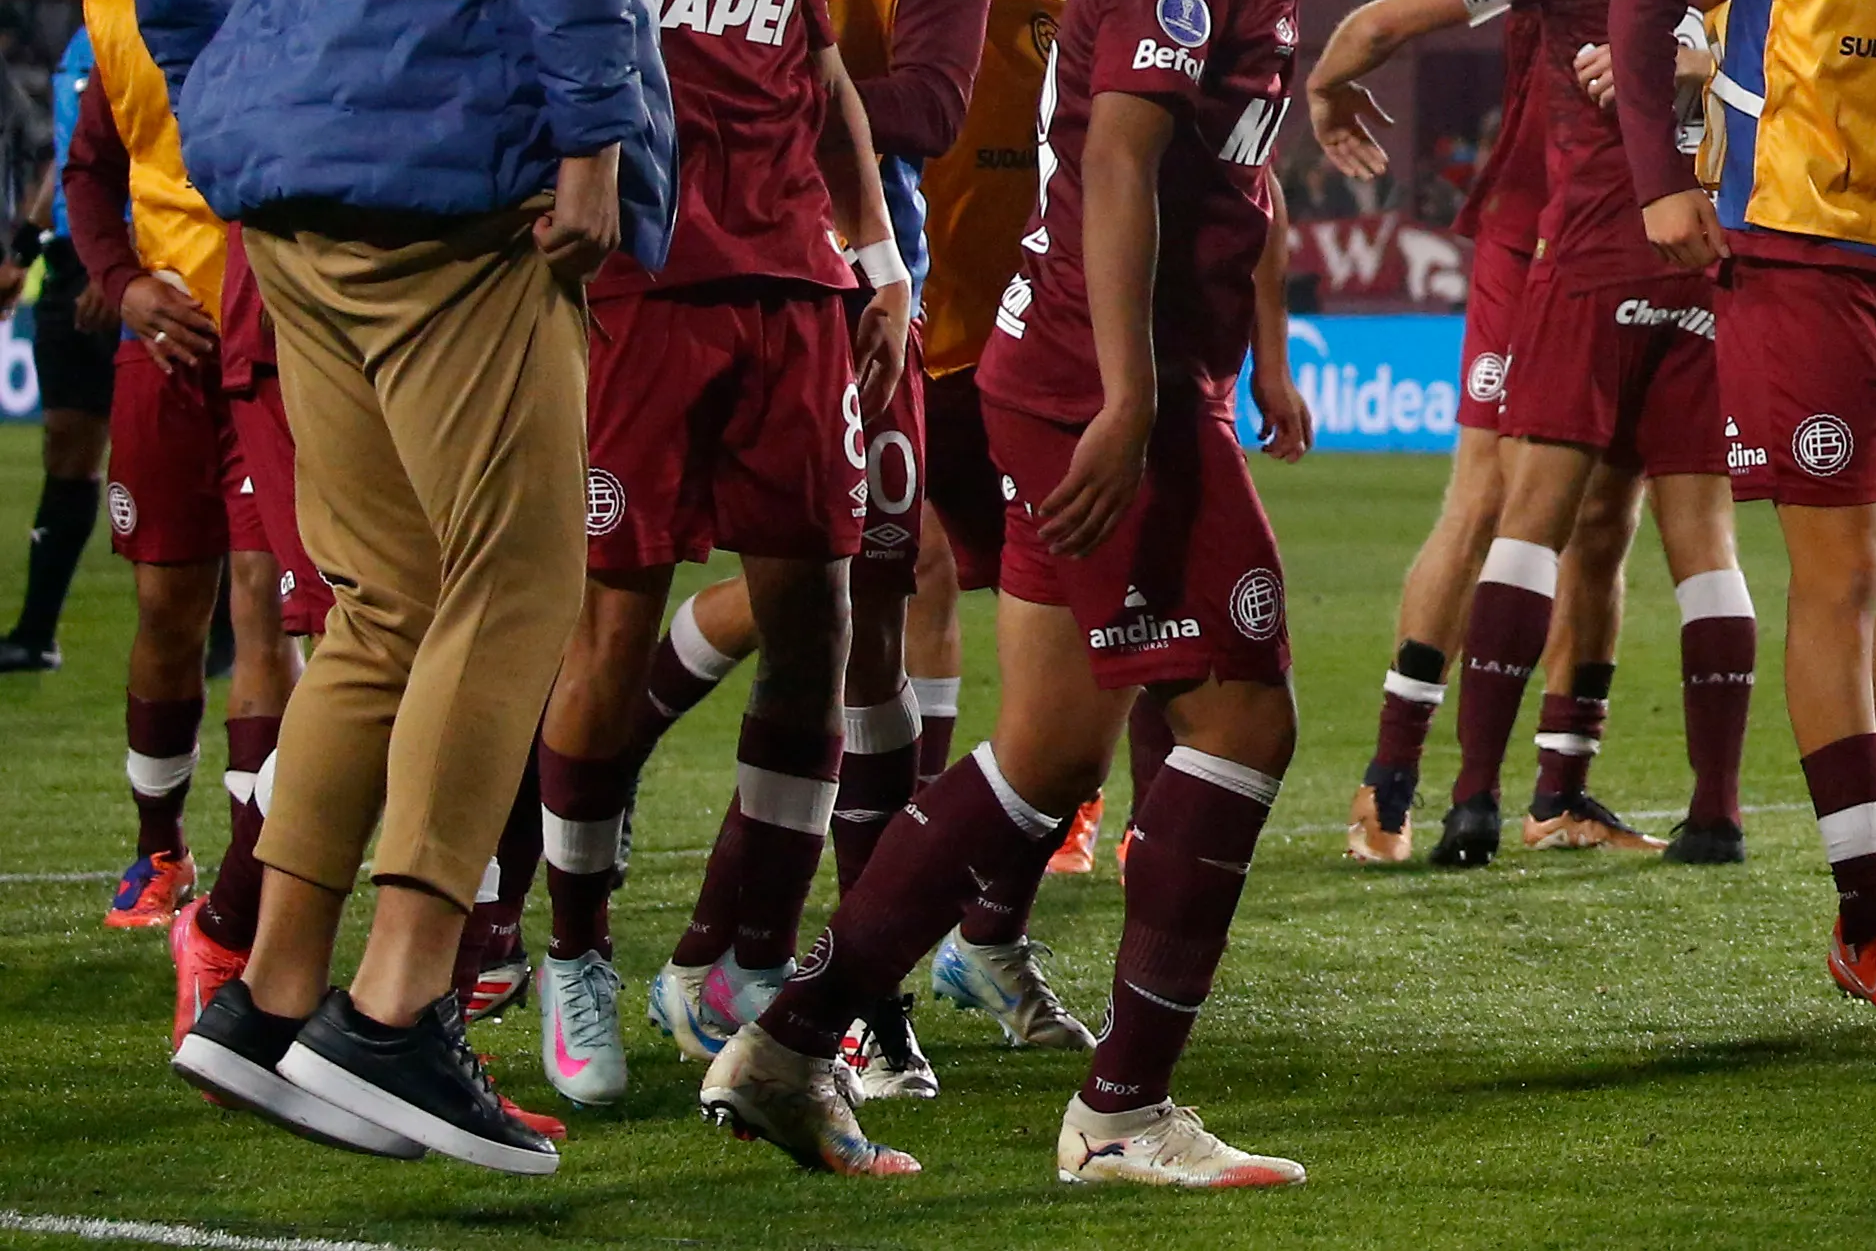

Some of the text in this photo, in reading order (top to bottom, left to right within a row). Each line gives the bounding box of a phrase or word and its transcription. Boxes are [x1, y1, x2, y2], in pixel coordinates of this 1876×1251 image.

[1296, 363, 1457, 436] Midea
[1088, 613, 1201, 649] andina
[1094, 1075, 1140, 1096] TIFOX
